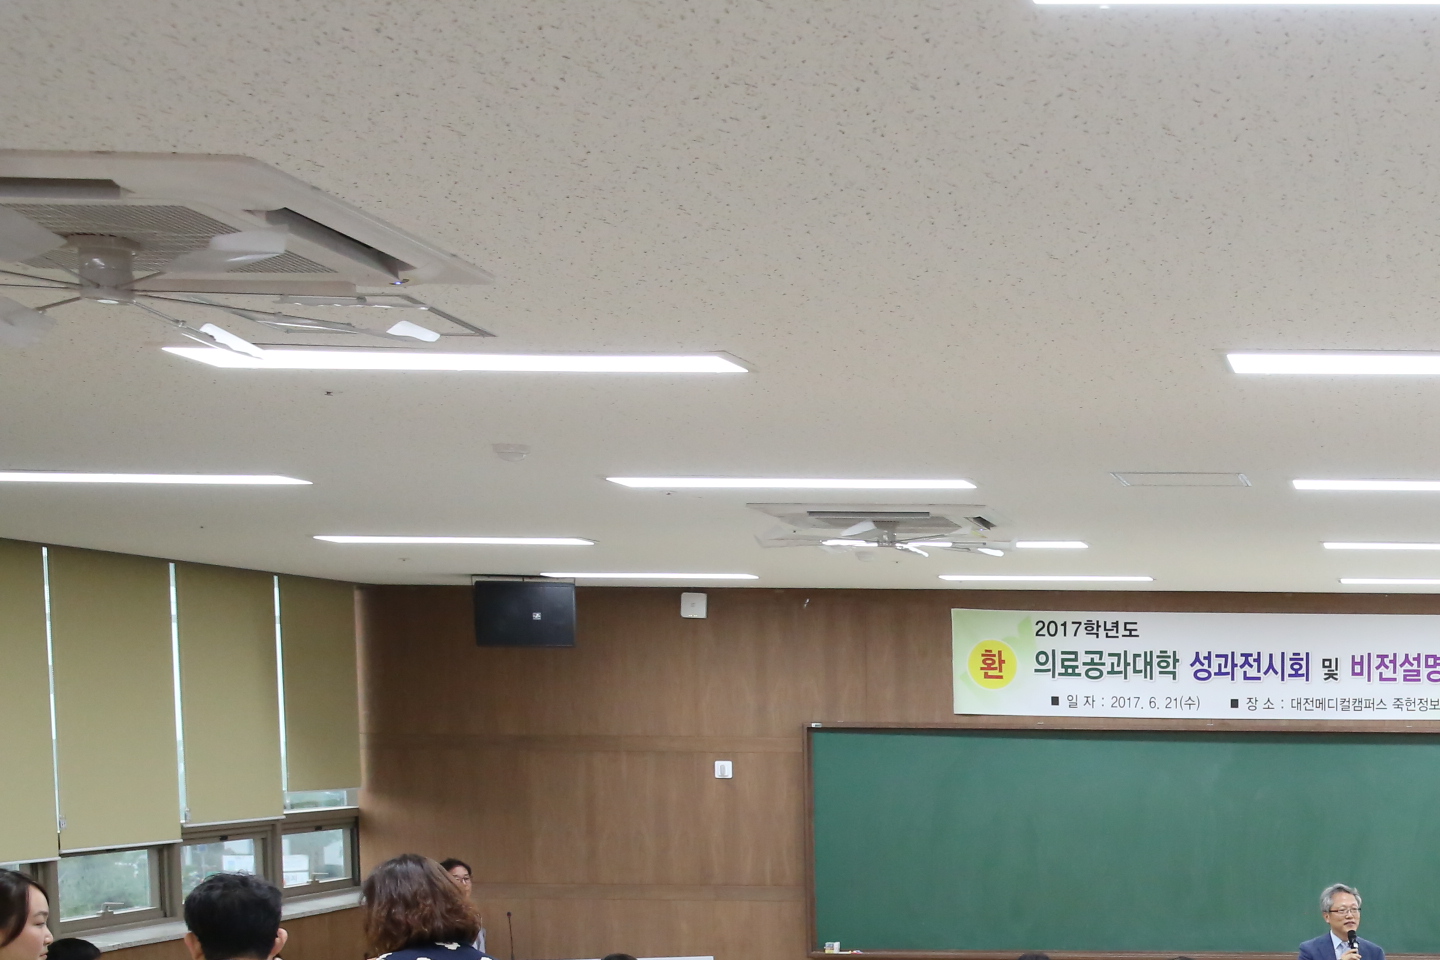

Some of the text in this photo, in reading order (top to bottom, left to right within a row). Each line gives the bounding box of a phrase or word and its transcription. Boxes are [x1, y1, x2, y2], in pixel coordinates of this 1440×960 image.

[1035, 619, 1140, 639] 2017학년도
[979, 649, 1006, 680] 환
[1034, 649, 1180, 681] 의료공과대학
[1189, 650, 1311, 682] 성과전시회
[1321, 656, 1340, 682] 및
[1165, 696, 1201, 712] 21(수)
[1290, 697, 1388, 713] 대전메디컬캠퍼스
